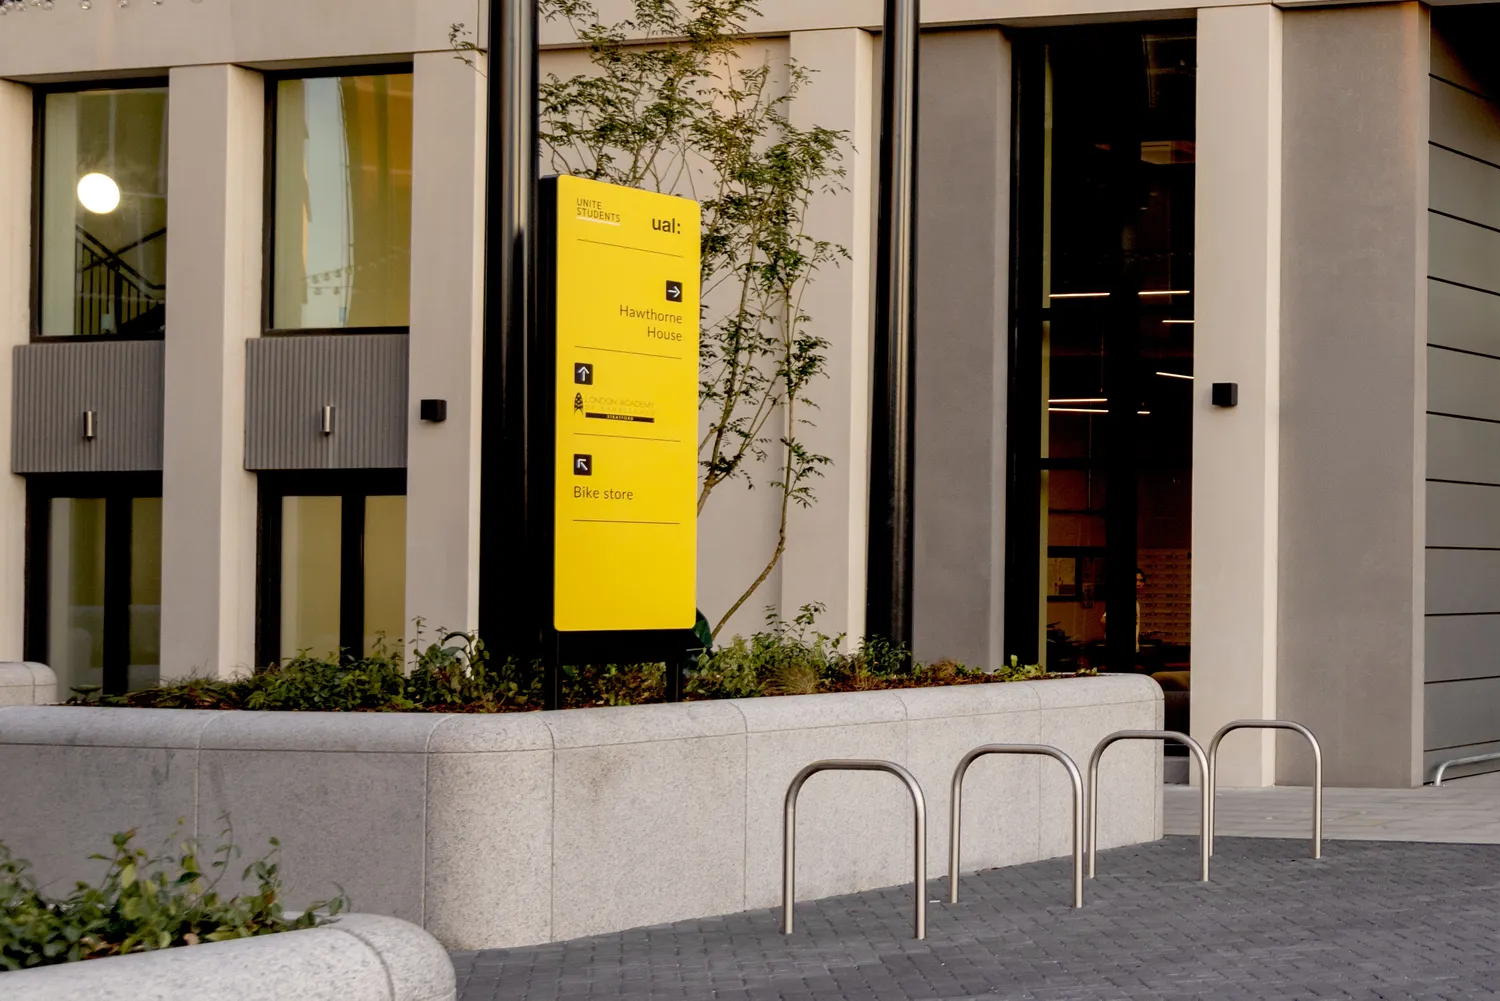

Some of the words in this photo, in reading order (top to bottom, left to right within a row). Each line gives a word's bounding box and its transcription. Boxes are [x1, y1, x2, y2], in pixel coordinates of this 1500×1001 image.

[577, 198, 602, 210] UNITE
[577, 207, 621, 222] STUDENTS
[652, 218, 681, 235] ual:
[620, 304, 683, 324] Hawthorne
[647, 326, 683, 341] House
[573, 486, 600, 498] Bike
[604, 488, 634, 501] store
